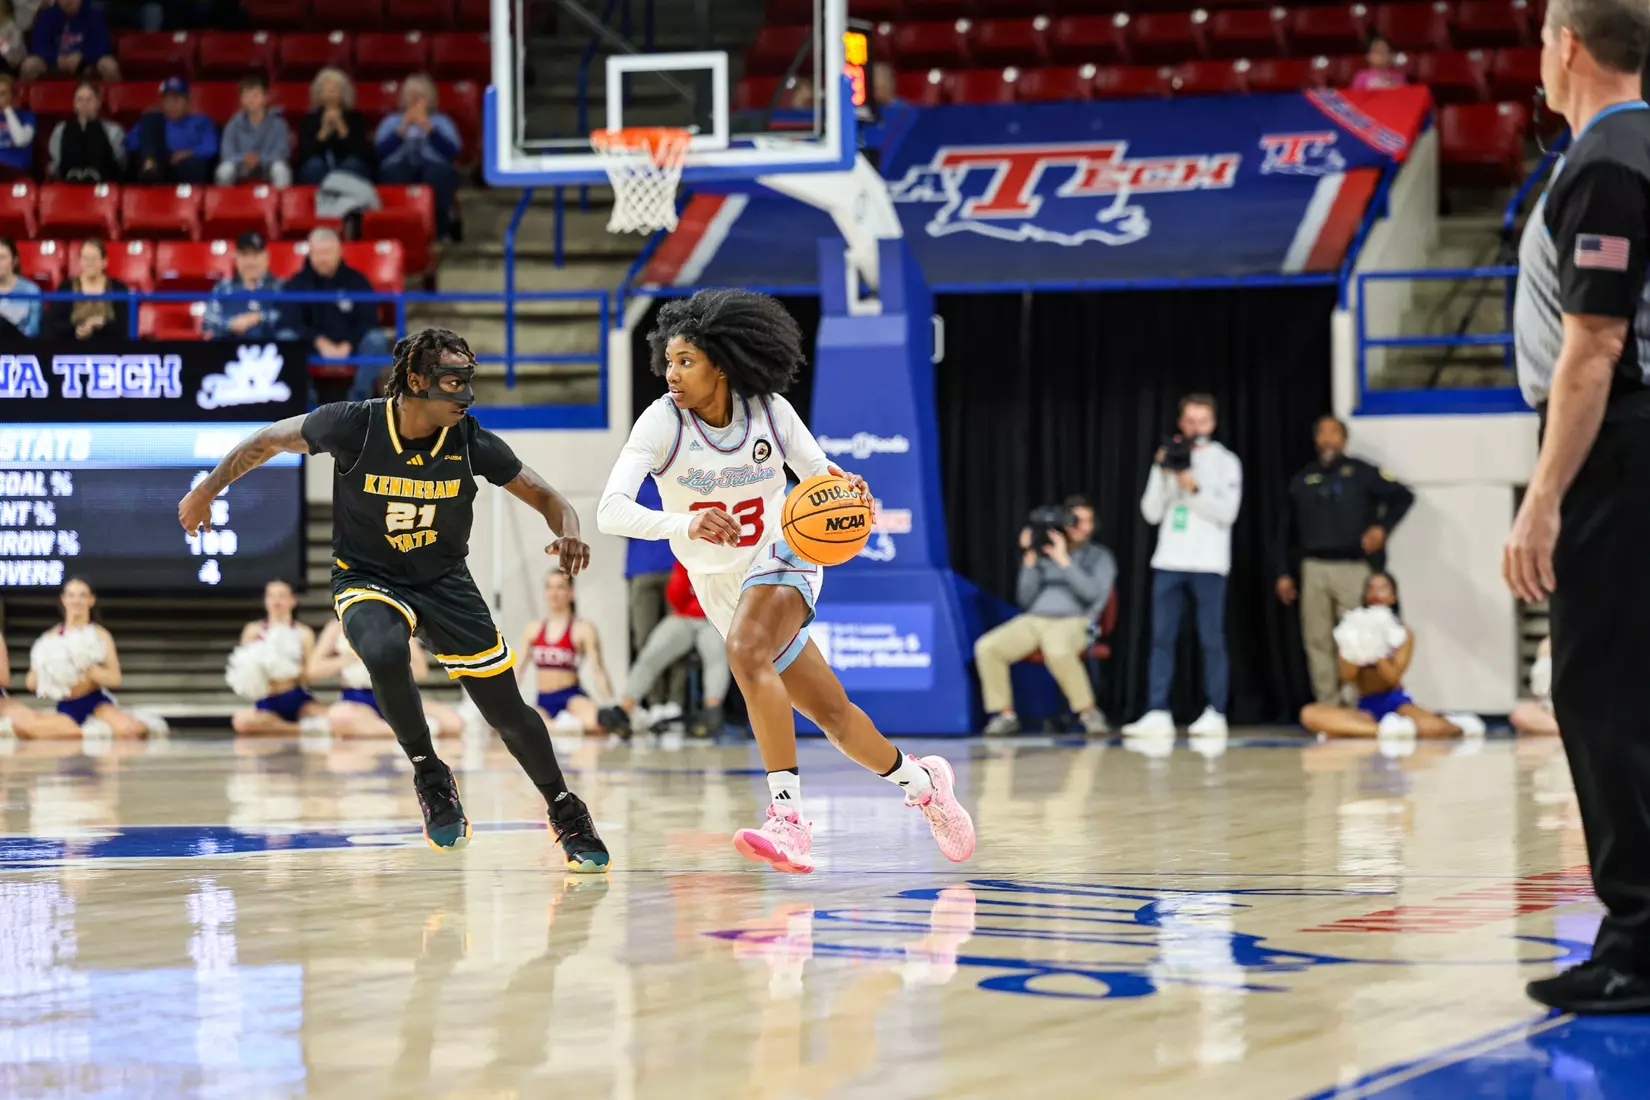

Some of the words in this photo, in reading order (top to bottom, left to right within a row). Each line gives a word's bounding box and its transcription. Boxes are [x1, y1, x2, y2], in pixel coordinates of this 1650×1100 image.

[52, 354, 182, 398] TECH
[50, 471, 73, 496] %
[363, 474, 461, 499] KENNESAW
[677, 467, 716, 495] Lady
[716, 463, 776, 488] Techsters
[385, 501, 436, 533] 21
[825, 513, 866, 532] NCAA
[0, 530, 56, 556] ROW
